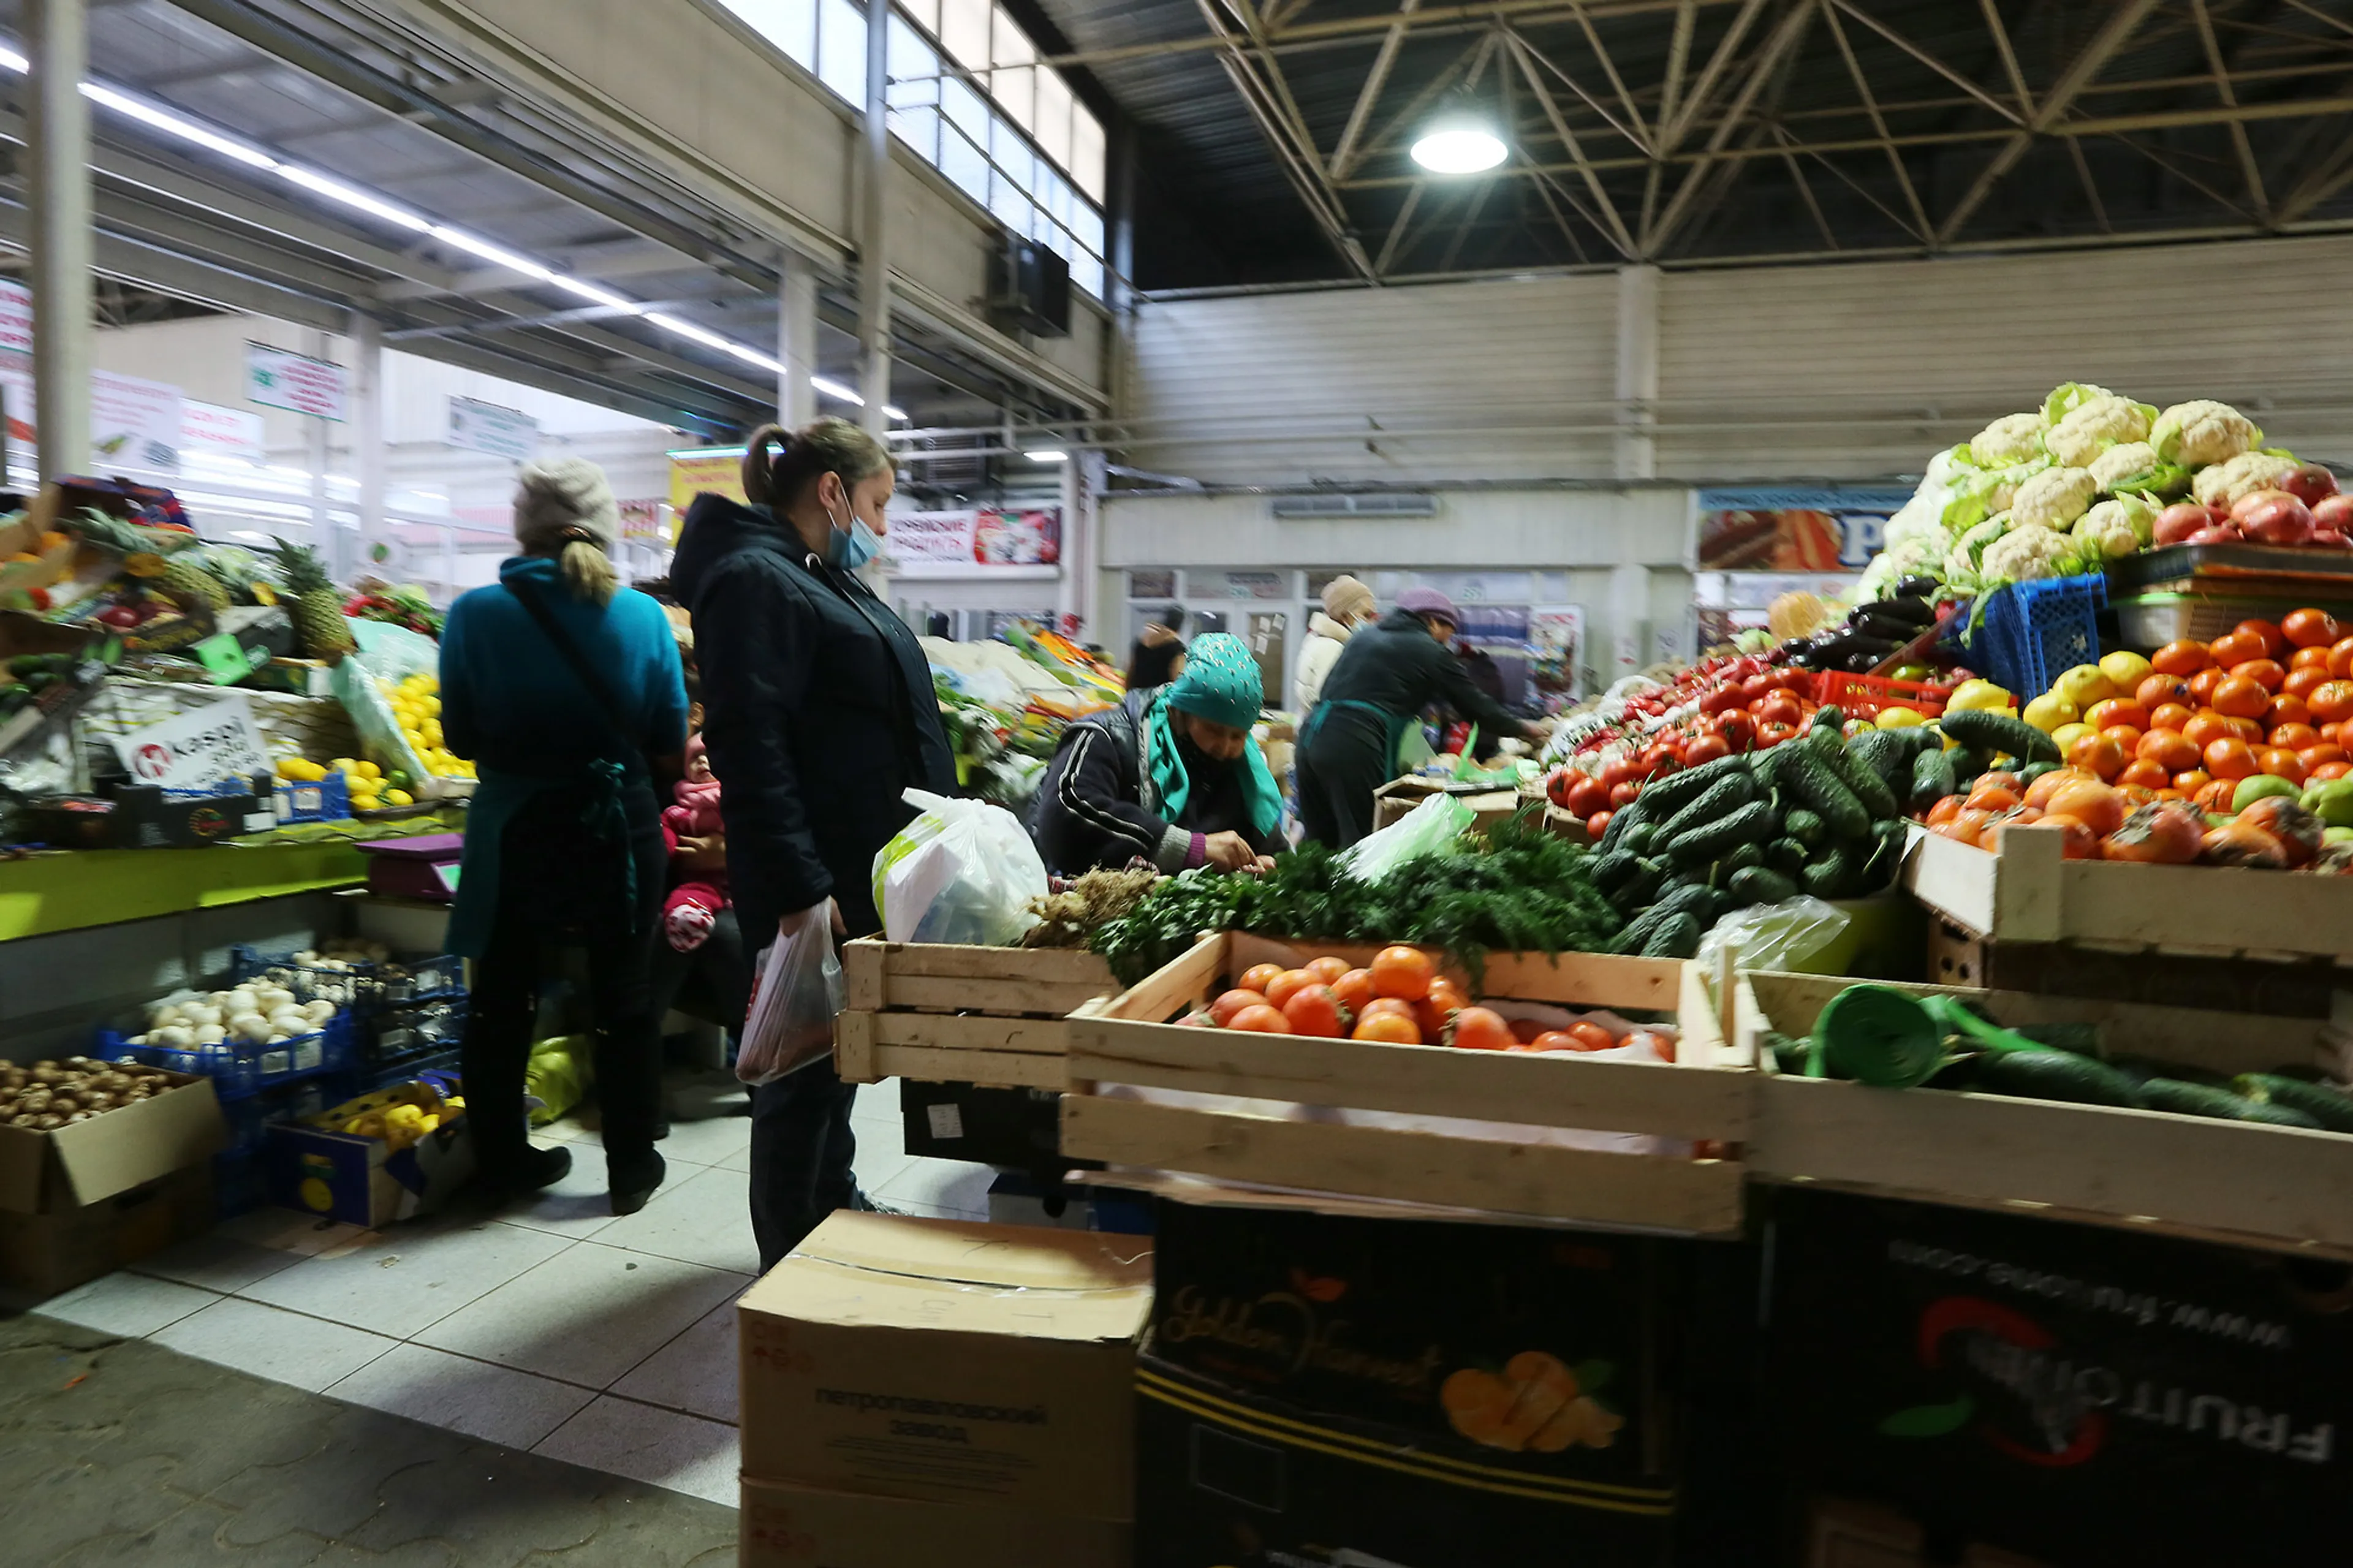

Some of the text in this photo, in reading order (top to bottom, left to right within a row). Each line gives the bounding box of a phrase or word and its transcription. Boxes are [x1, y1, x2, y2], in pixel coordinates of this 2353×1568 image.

[165, 716, 246, 757] kaspi
[815, 1386, 1048, 1426] петропавловский
[889, 1418, 969, 1445] завод
